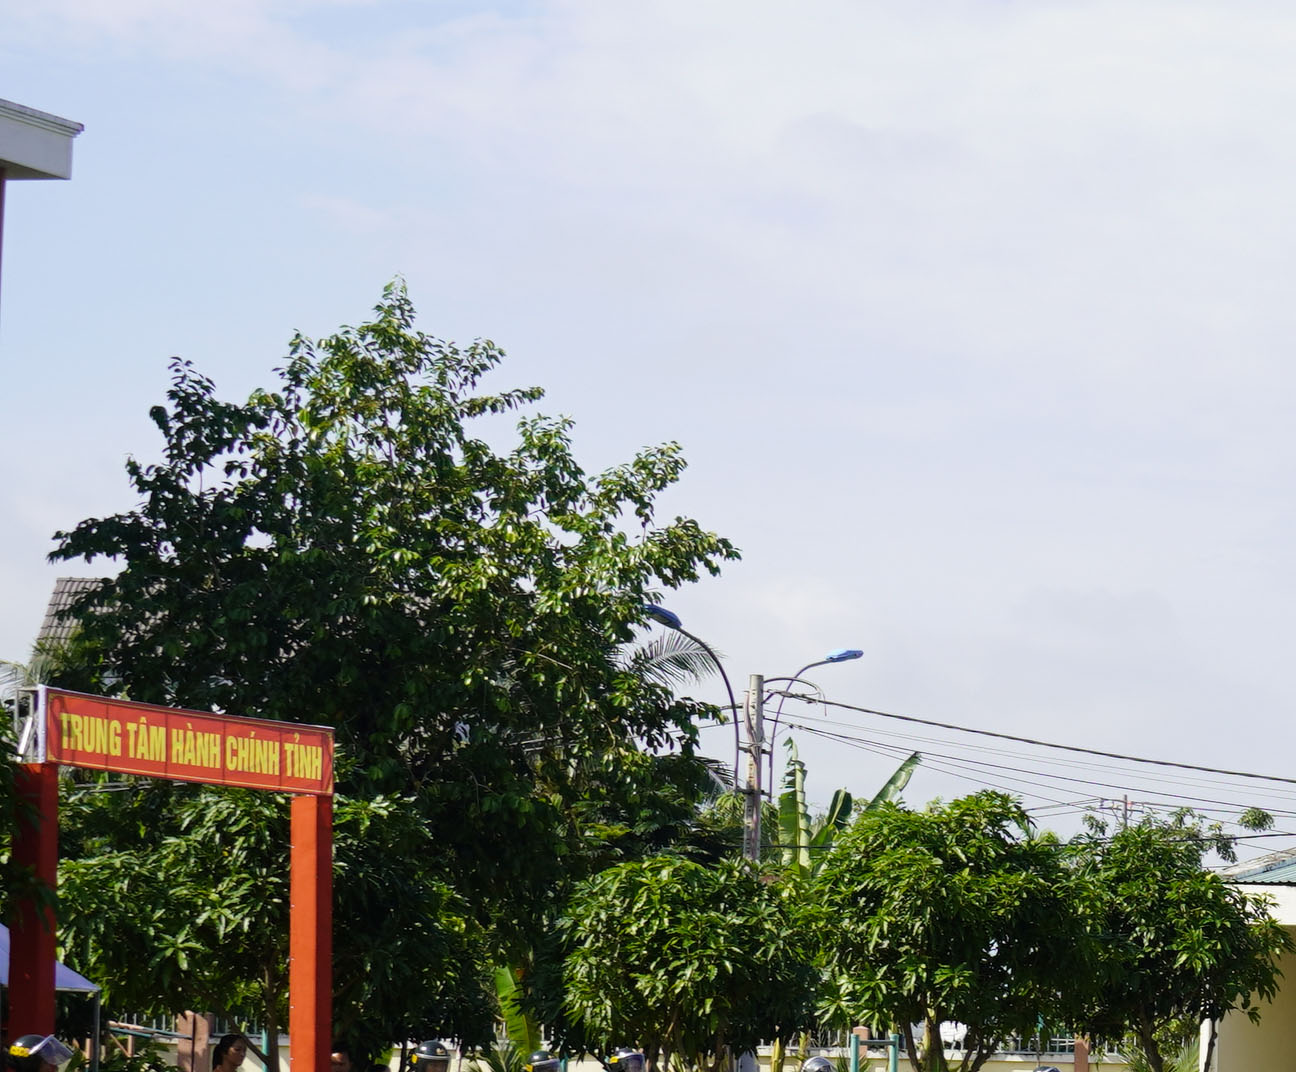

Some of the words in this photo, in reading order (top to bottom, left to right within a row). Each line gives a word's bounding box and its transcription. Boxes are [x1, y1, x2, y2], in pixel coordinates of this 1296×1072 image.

[60, 712, 121, 756] TRUNG
[126, 716, 167, 762] TÂM
[171, 722, 220, 769] HÀNH
[225, 731, 280, 775] CHÍNH
[284, 732, 322, 780] TỈNH
